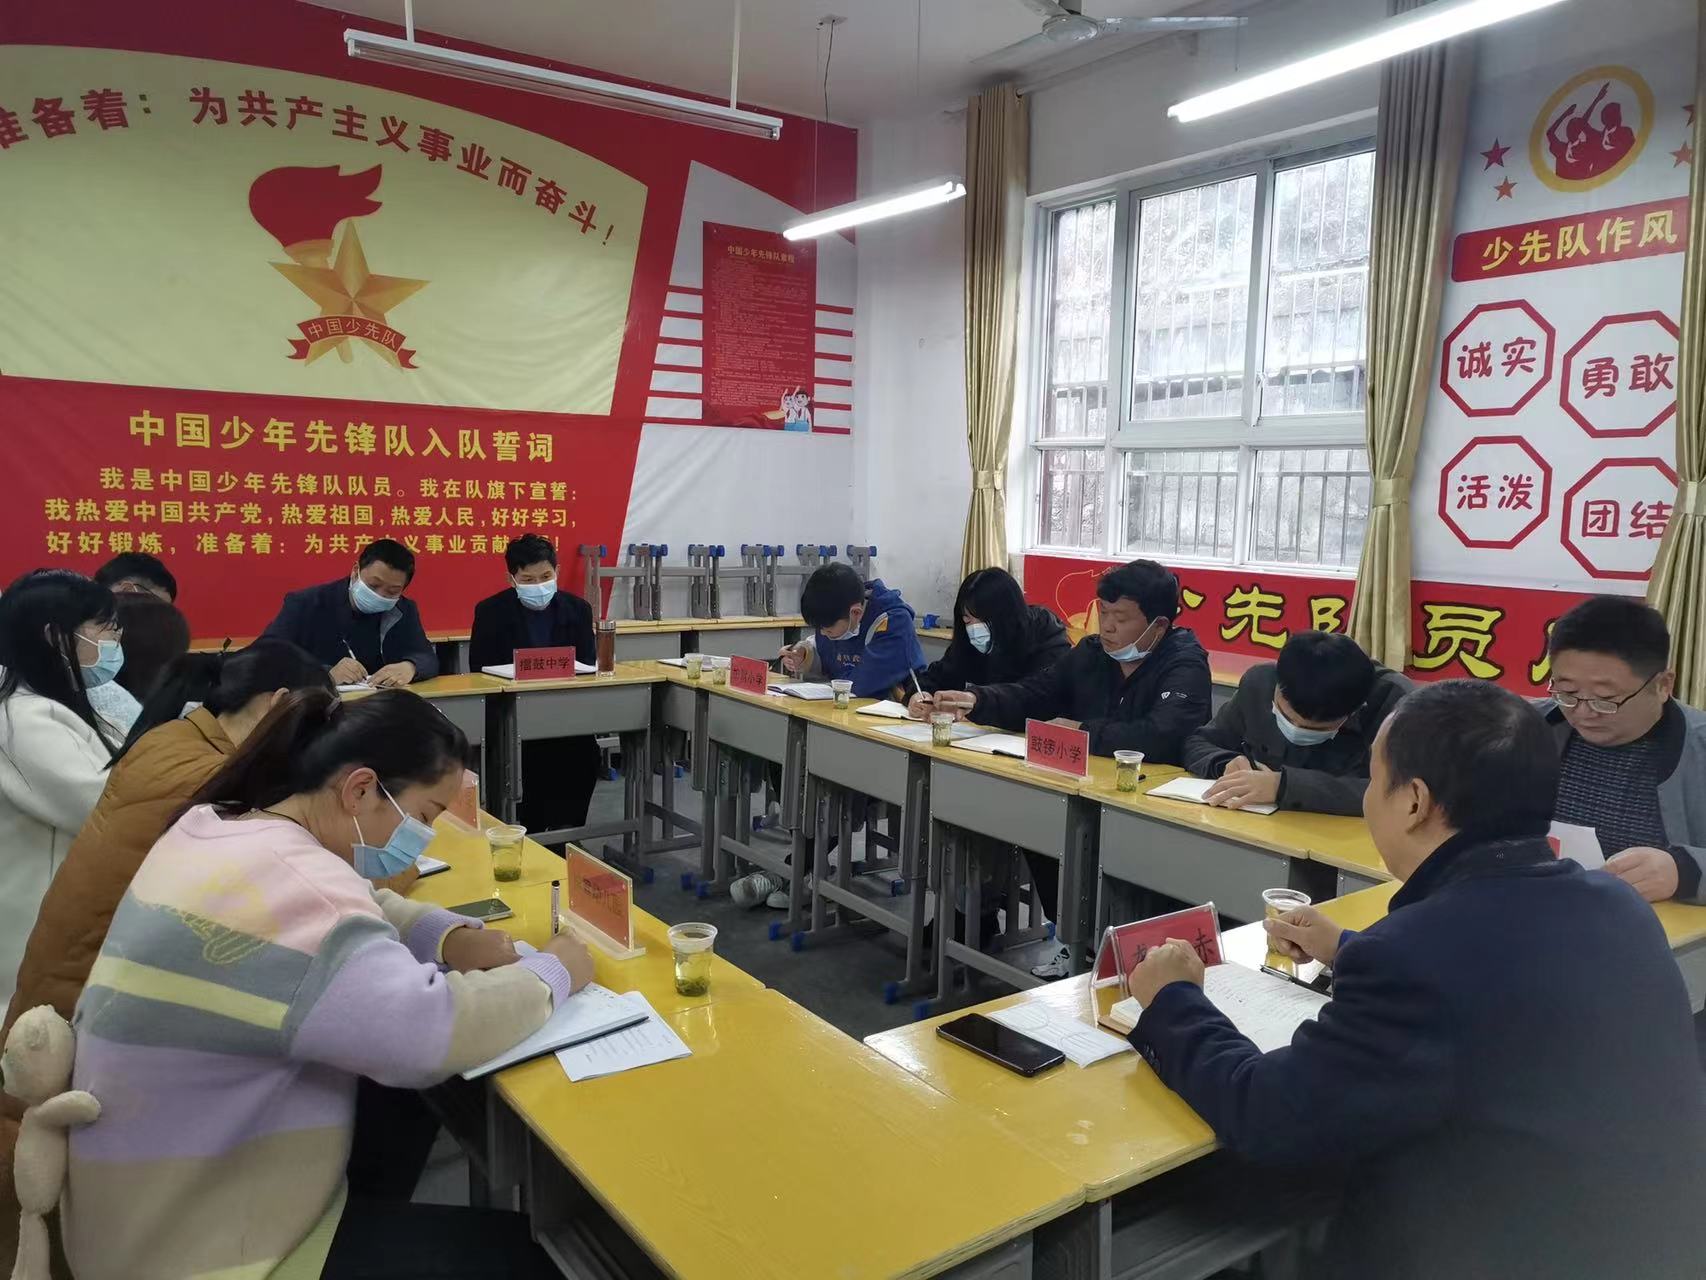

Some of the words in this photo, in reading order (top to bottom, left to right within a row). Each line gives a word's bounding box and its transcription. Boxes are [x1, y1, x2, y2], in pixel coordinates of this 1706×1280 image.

[1482, 210, 1677, 271] 少先队作风
[308, 319, 396, 348] 中国少先队
[1456, 337, 1536, 378] 诚实
[1582, 353, 1675, 399] 勇敢
[129, 410, 554, 463] 中国少年先锋队入队誓词
[1456, 474, 1534, 510] 活泼
[1581, 500, 1673, 540] 团结
